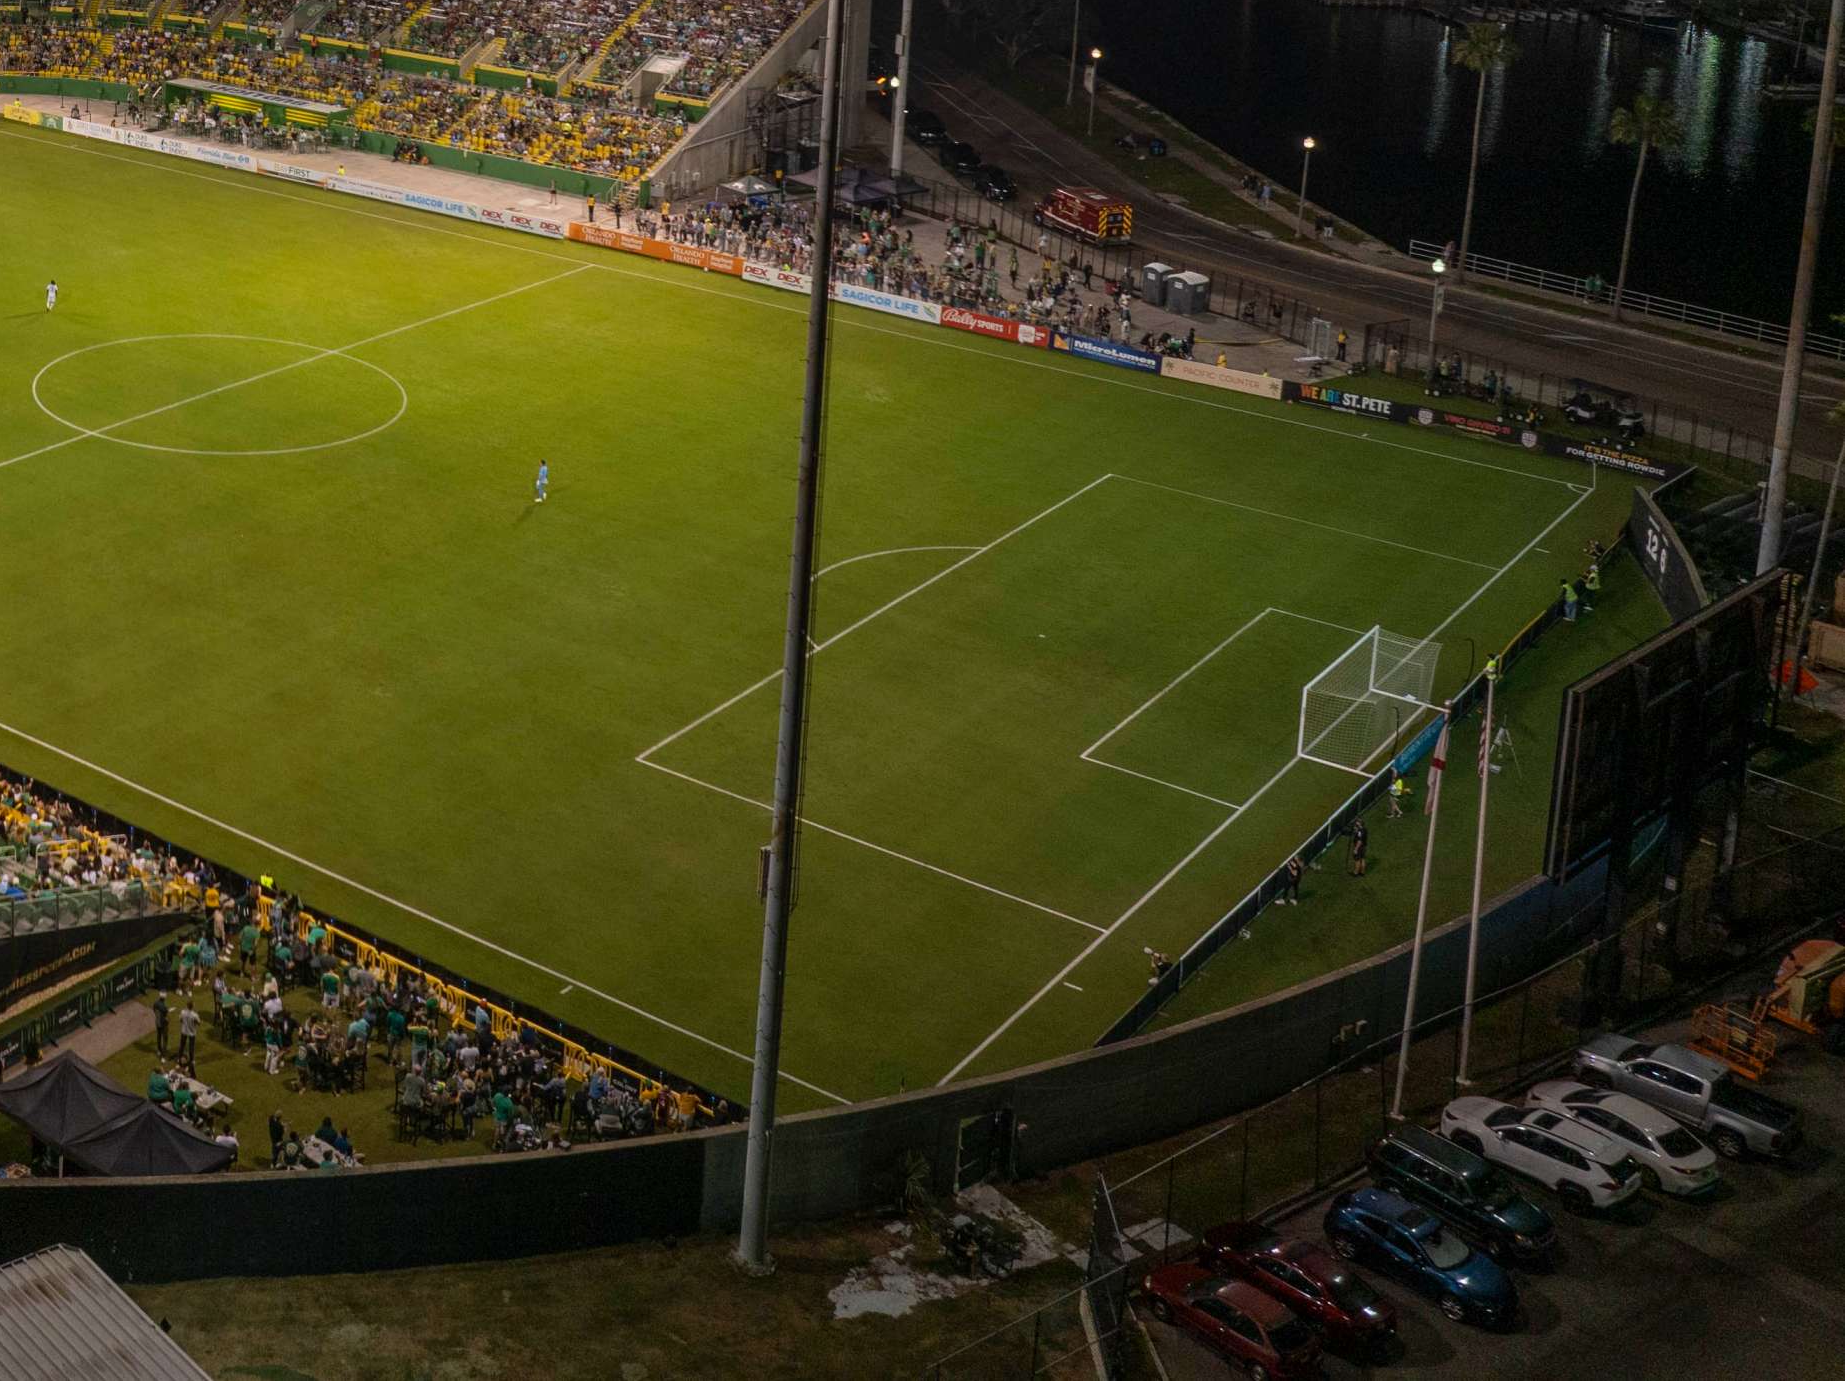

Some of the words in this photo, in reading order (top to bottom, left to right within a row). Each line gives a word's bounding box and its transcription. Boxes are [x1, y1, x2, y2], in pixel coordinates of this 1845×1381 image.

[405, 194, 444, 208] SAGICOR
[445, 202, 463, 213] LIFE
[481, 209, 503, 219] DEX
[510, 215, 532, 226] DEX
[539, 221, 562, 232] DEX
[581, 226, 616, 239] ORLANDO
[669, 244, 705, 259] ORLANDO
[743, 265, 768, 277] DEX
[776, 272, 803, 285] DEX
[841, 288, 893, 308] SAGICOR
[894, 300, 919, 314] LIFE
[942, 308, 977, 330] Bally
[977, 319, 1004, 333] SPORTS
[1074, 339, 1156, 366] MicroLumen
[1183, 366, 1216, 381] PACIFIC
[1218, 374, 1260, 389] COUNTER
[1299, 383, 1319, 401] WE
[1319, 386, 1340, 403] ARE
[1565, 446, 1586, 458] FOR
[1585, 450, 1626, 467] GETTING
[1627, 461, 1666, 477] ROWDIE
[1602, 448, 1621, 459] THE
[1621, 452, 1649, 466] PIZZA
